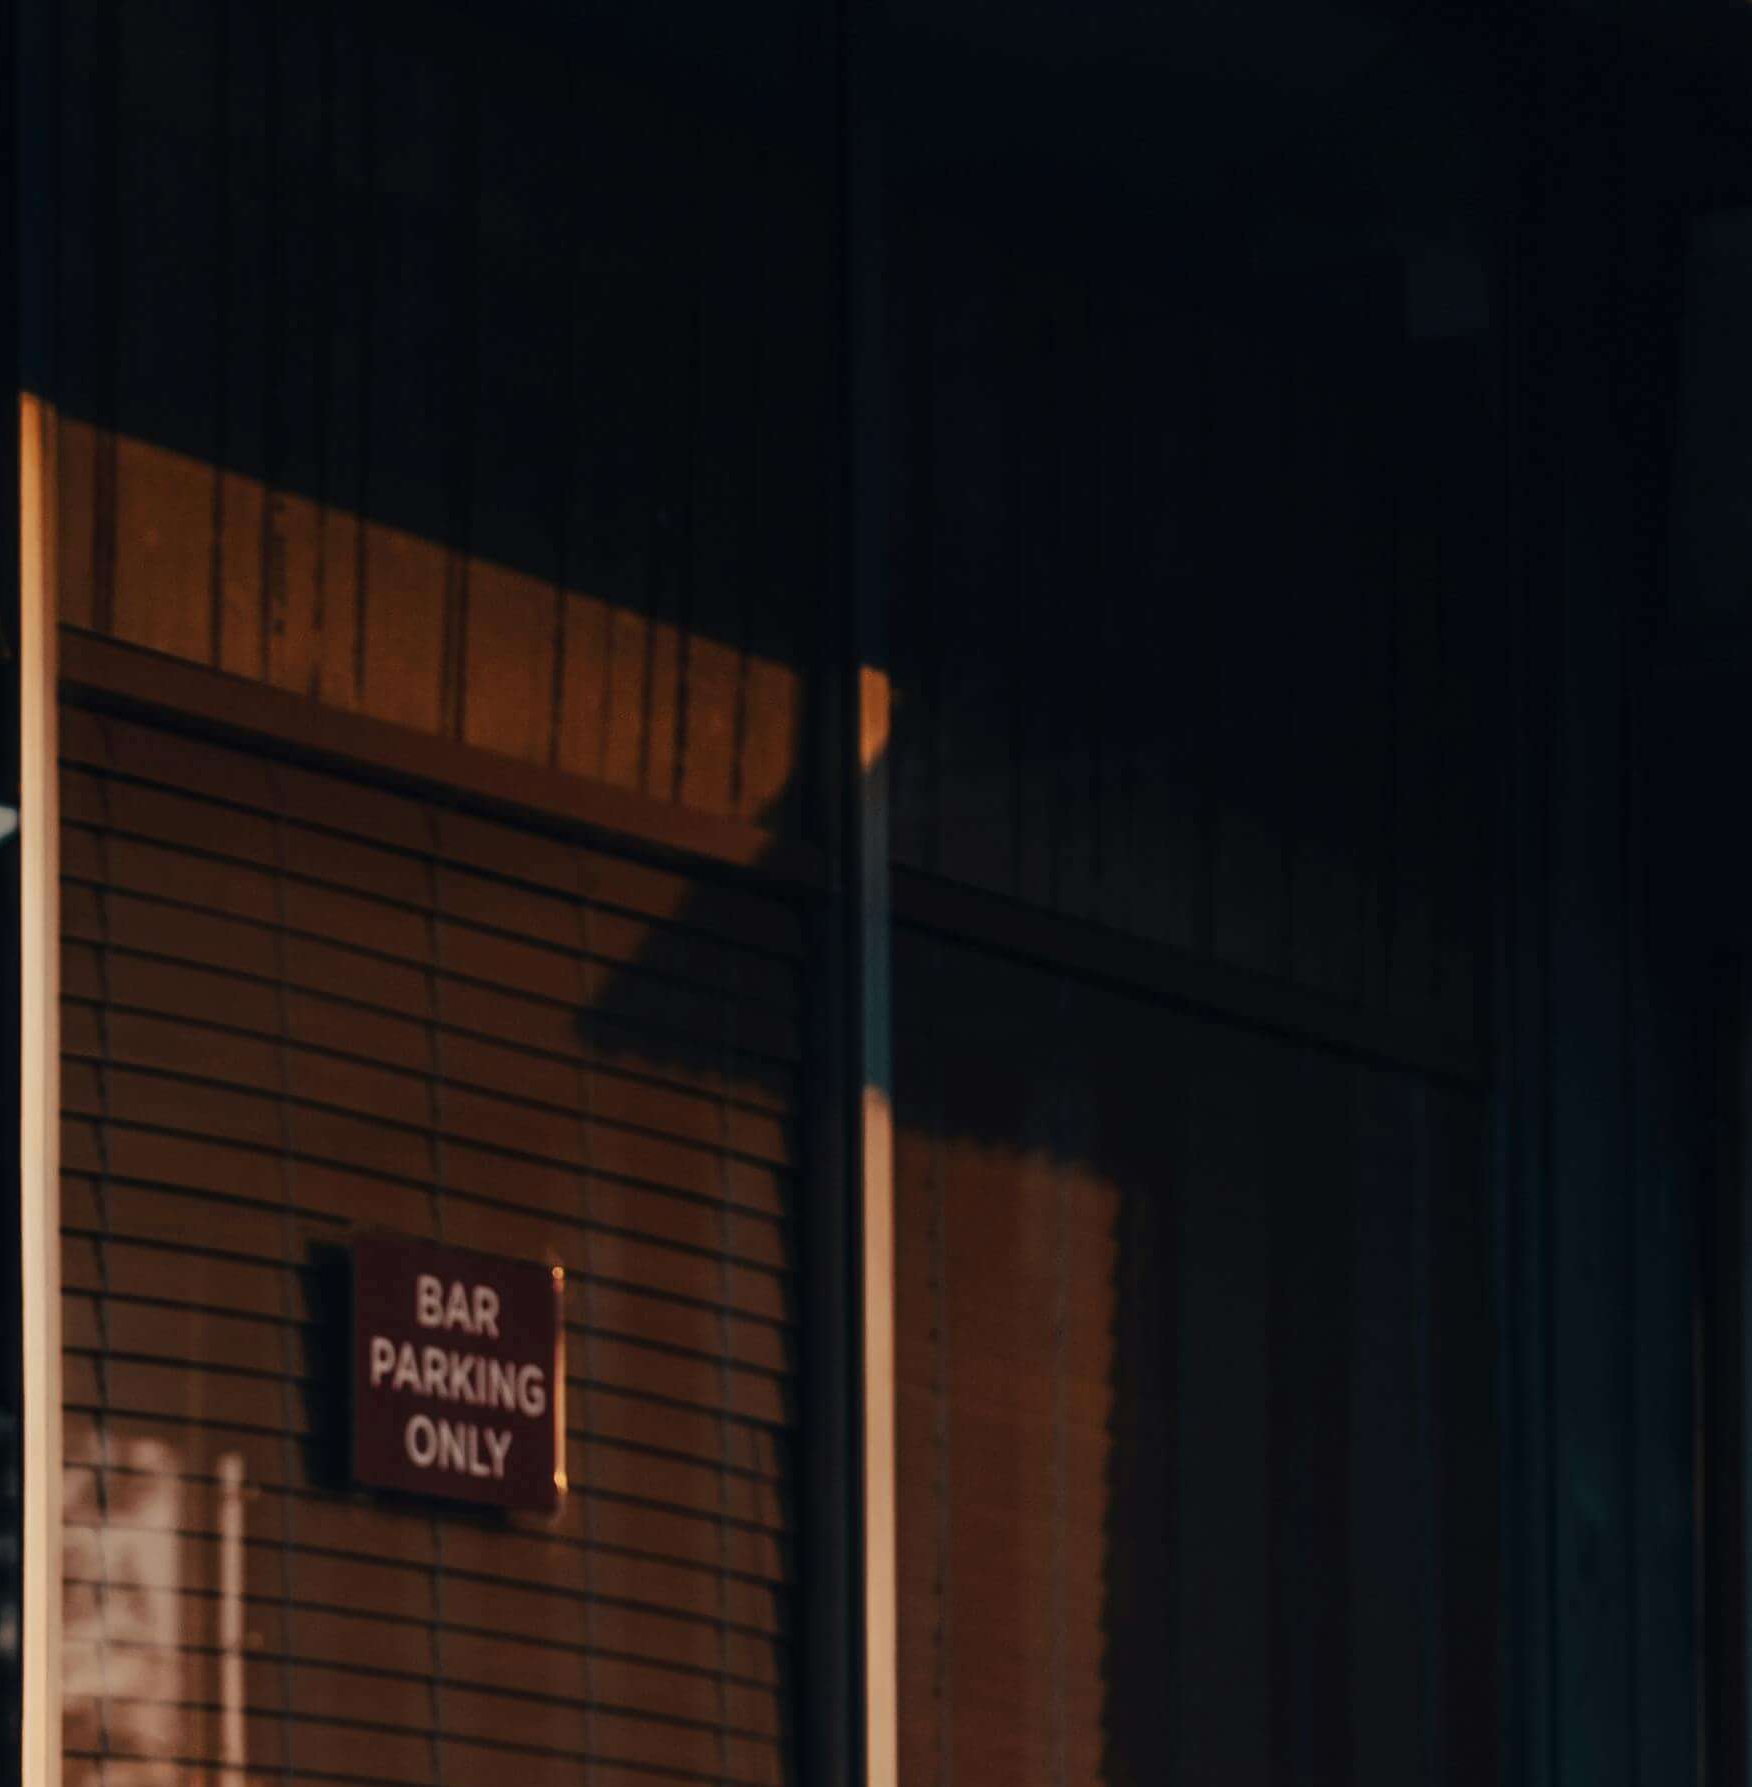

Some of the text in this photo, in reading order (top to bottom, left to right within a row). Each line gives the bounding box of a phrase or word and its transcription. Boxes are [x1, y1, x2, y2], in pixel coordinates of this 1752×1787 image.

[416, 1273, 500, 1337] BAR
[369, 1335, 547, 1418] PARKING
[404, 1413, 513, 1479] ONLY
